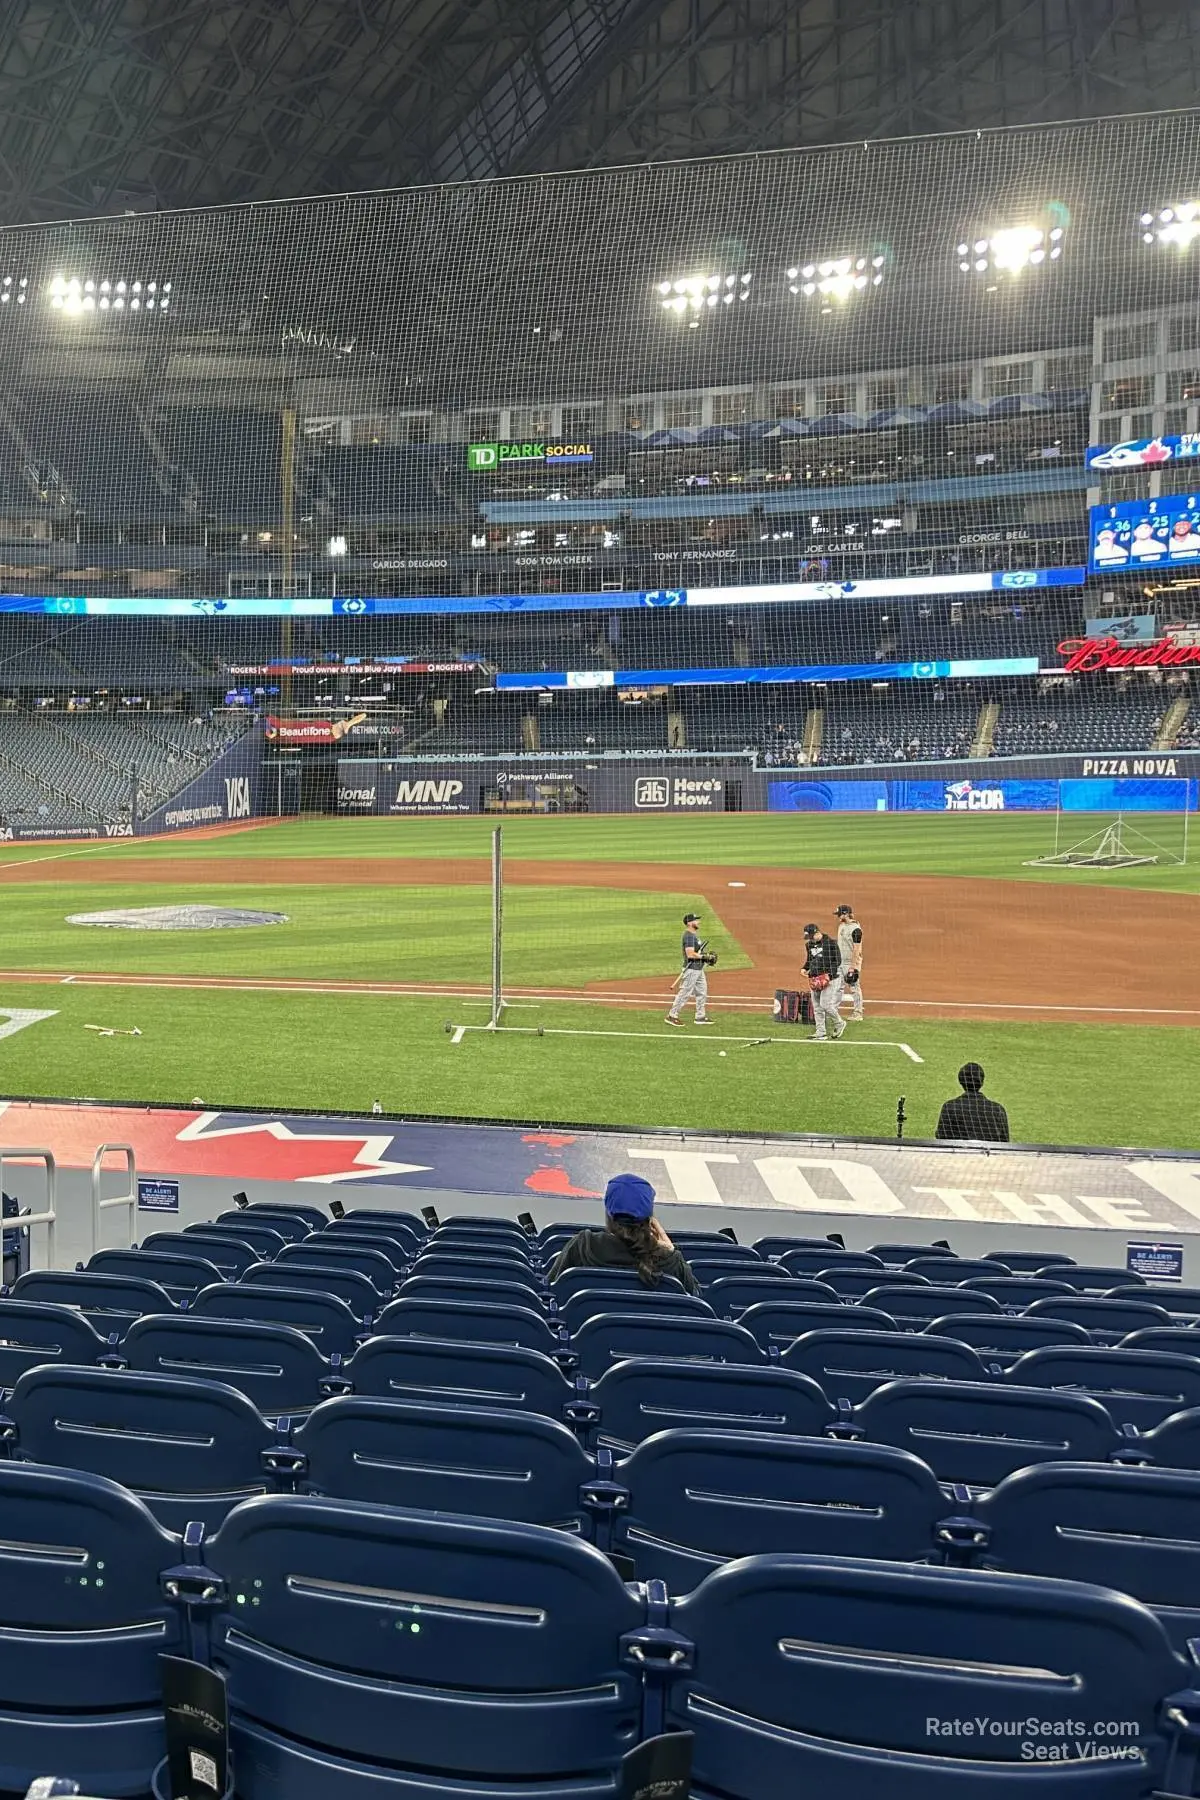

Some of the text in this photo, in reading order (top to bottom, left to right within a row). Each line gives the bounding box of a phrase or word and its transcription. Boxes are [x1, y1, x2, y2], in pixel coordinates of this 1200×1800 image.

[471, 443, 594, 465] TD PARK SOCIAL
[1149, 501, 1157, 514] 2
[1187, 497, 1196, 509] 3
[1110, 507, 1116, 518] 1
[1115, 520, 1131, 532] 36
[1153, 515, 1169, 528] 25
[959, 530, 1029, 544] GEORGE BELL
[804, 542, 864, 554] JOE CARTER
[515, 555, 593, 566] 4306 TOM CHEEK
[653, 550, 737, 561] TONY FERNANDEZ
[373, 559, 448, 569] CARLOS DELGADO
[230, 667, 258, 675] ROGERS
[291, 666, 315, 674] Proud
[364, 665, 382, 673] Blue
[382, 665, 402, 675] Jays
[352, 726, 378, 735] RETHINK
[1083, 758, 1177, 776] PIZZA NOVA
[508, 773, 543, 782] Pathways
[673, 778, 722, 792] Here's
[225, 776, 250, 818] VISA
[395, 780, 464, 803] MNP
[673, 793, 712, 806] How.
[19, 829, 54, 837] everywhere
[104, 824, 134, 836] VISA
[627, 1148, 906, 1213] TO
[912, 1186, 1177, 1231] THE
